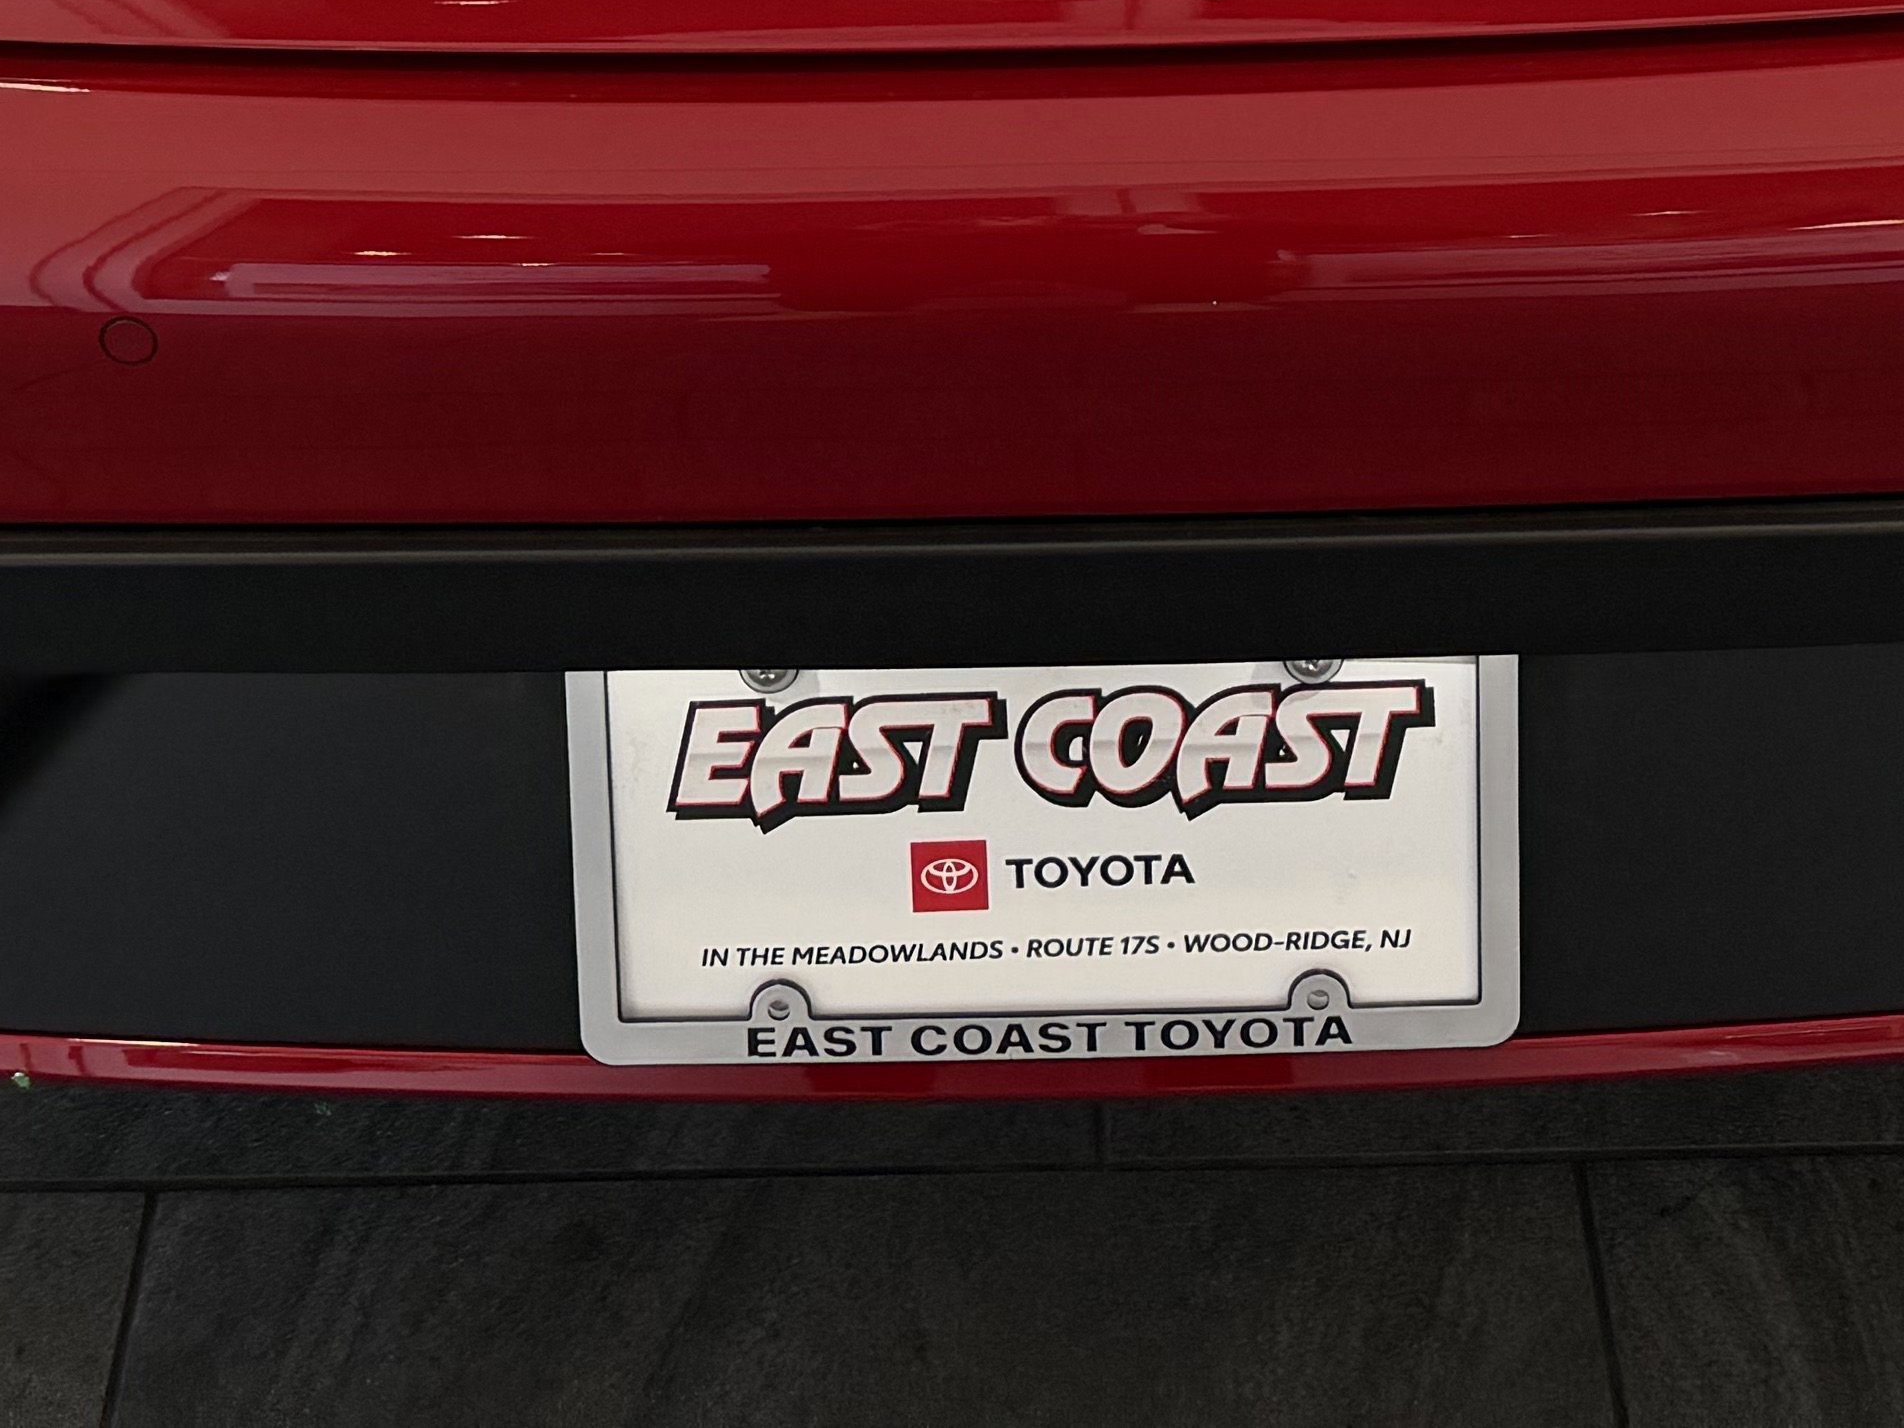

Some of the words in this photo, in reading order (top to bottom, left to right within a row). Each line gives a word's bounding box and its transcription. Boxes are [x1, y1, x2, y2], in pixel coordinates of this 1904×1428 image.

[666, 691, 1010, 835] EAST
[1014, 679, 1436, 821] COAST
[1004, 852, 1197, 891] TOYOTA
[701, 947, 729, 967] IN
[736, 946, 786, 966] THE
[791, 940, 1004, 965] MEADOWLANDS
[1026, 935, 1114, 958] ROUTE
[1119, 935, 1161, 956] 17S
[1183, 929, 1372, 953] WOOD-RIDGE,
[1379, 928, 1413, 949] NJ
[747, 1025, 893, 1058] EAST
[909, 1021, 1107, 1056] COAST
[1124, 1015, 1354, 1050] TOYOTA
